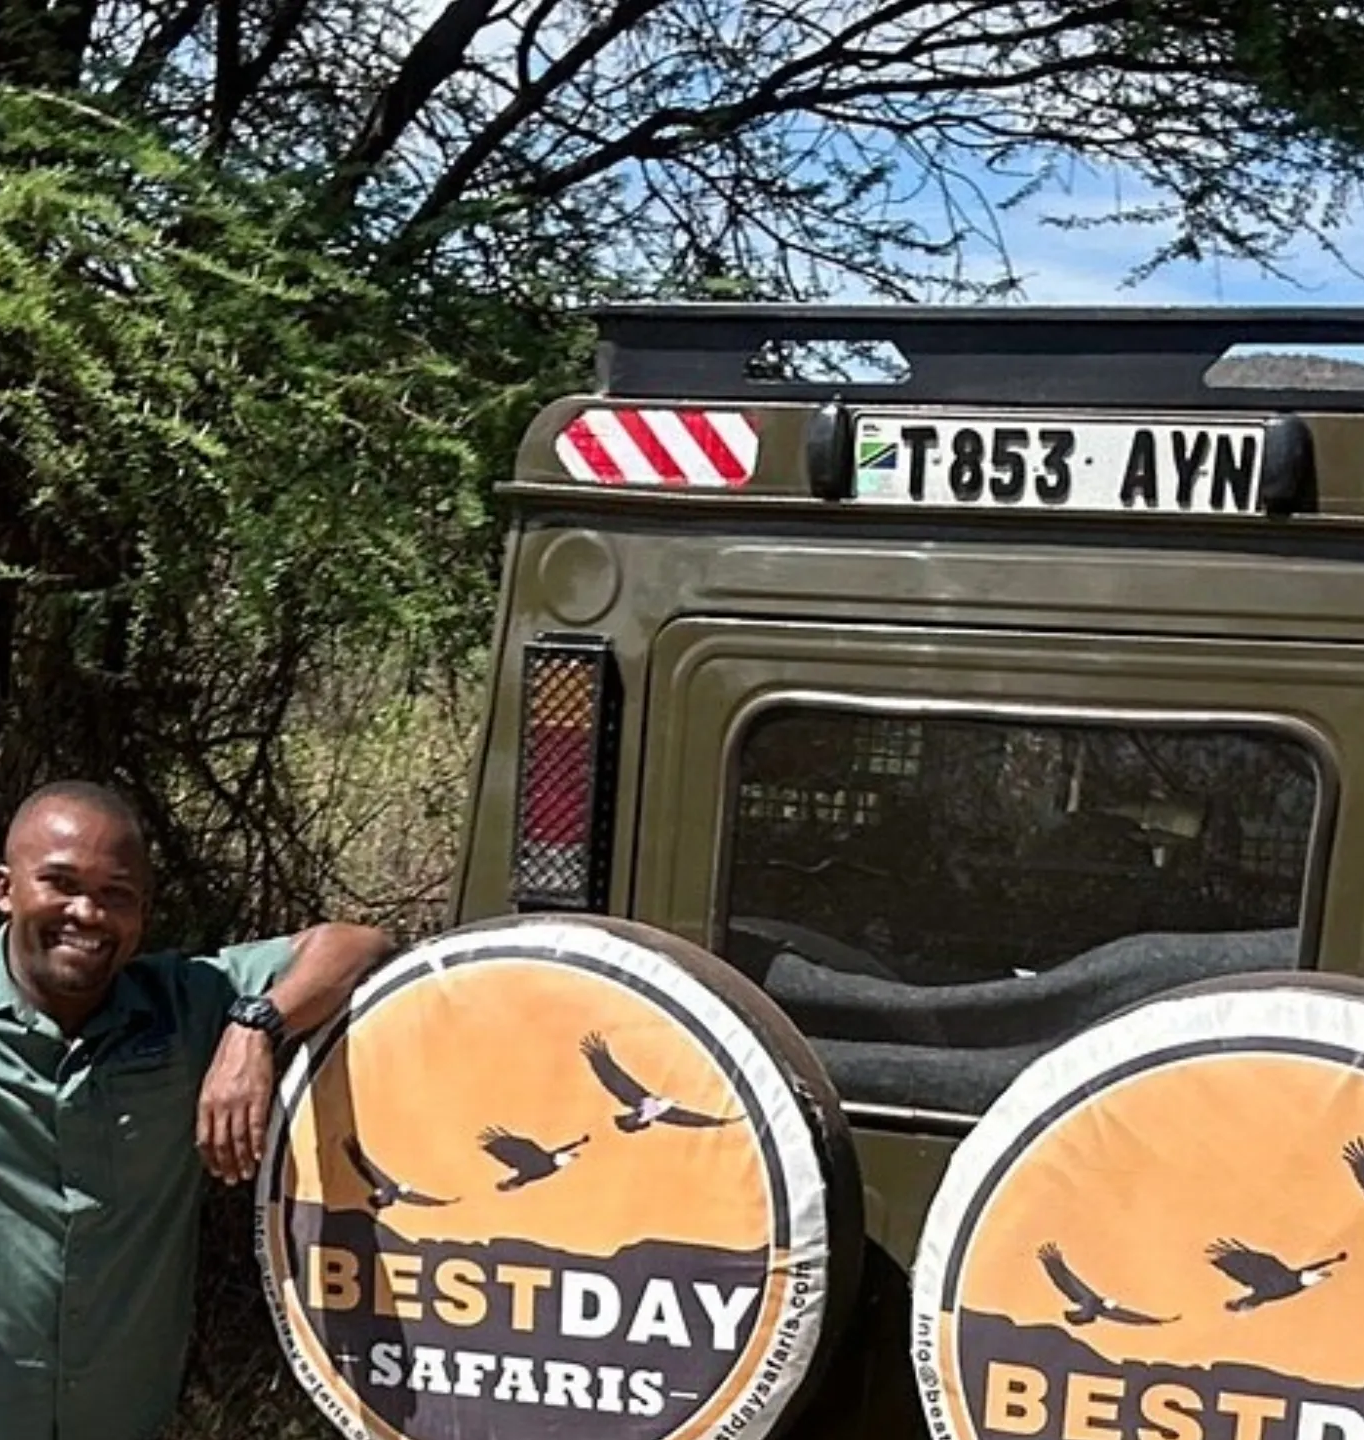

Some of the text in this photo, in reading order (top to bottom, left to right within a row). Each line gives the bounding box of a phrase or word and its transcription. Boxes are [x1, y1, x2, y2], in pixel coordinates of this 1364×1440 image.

[1119, 428, 1257, 511] AYN
[307, 1244, 760, 1350] BESTDAY
[369, 1341, 665, 1417] SAFARIS
